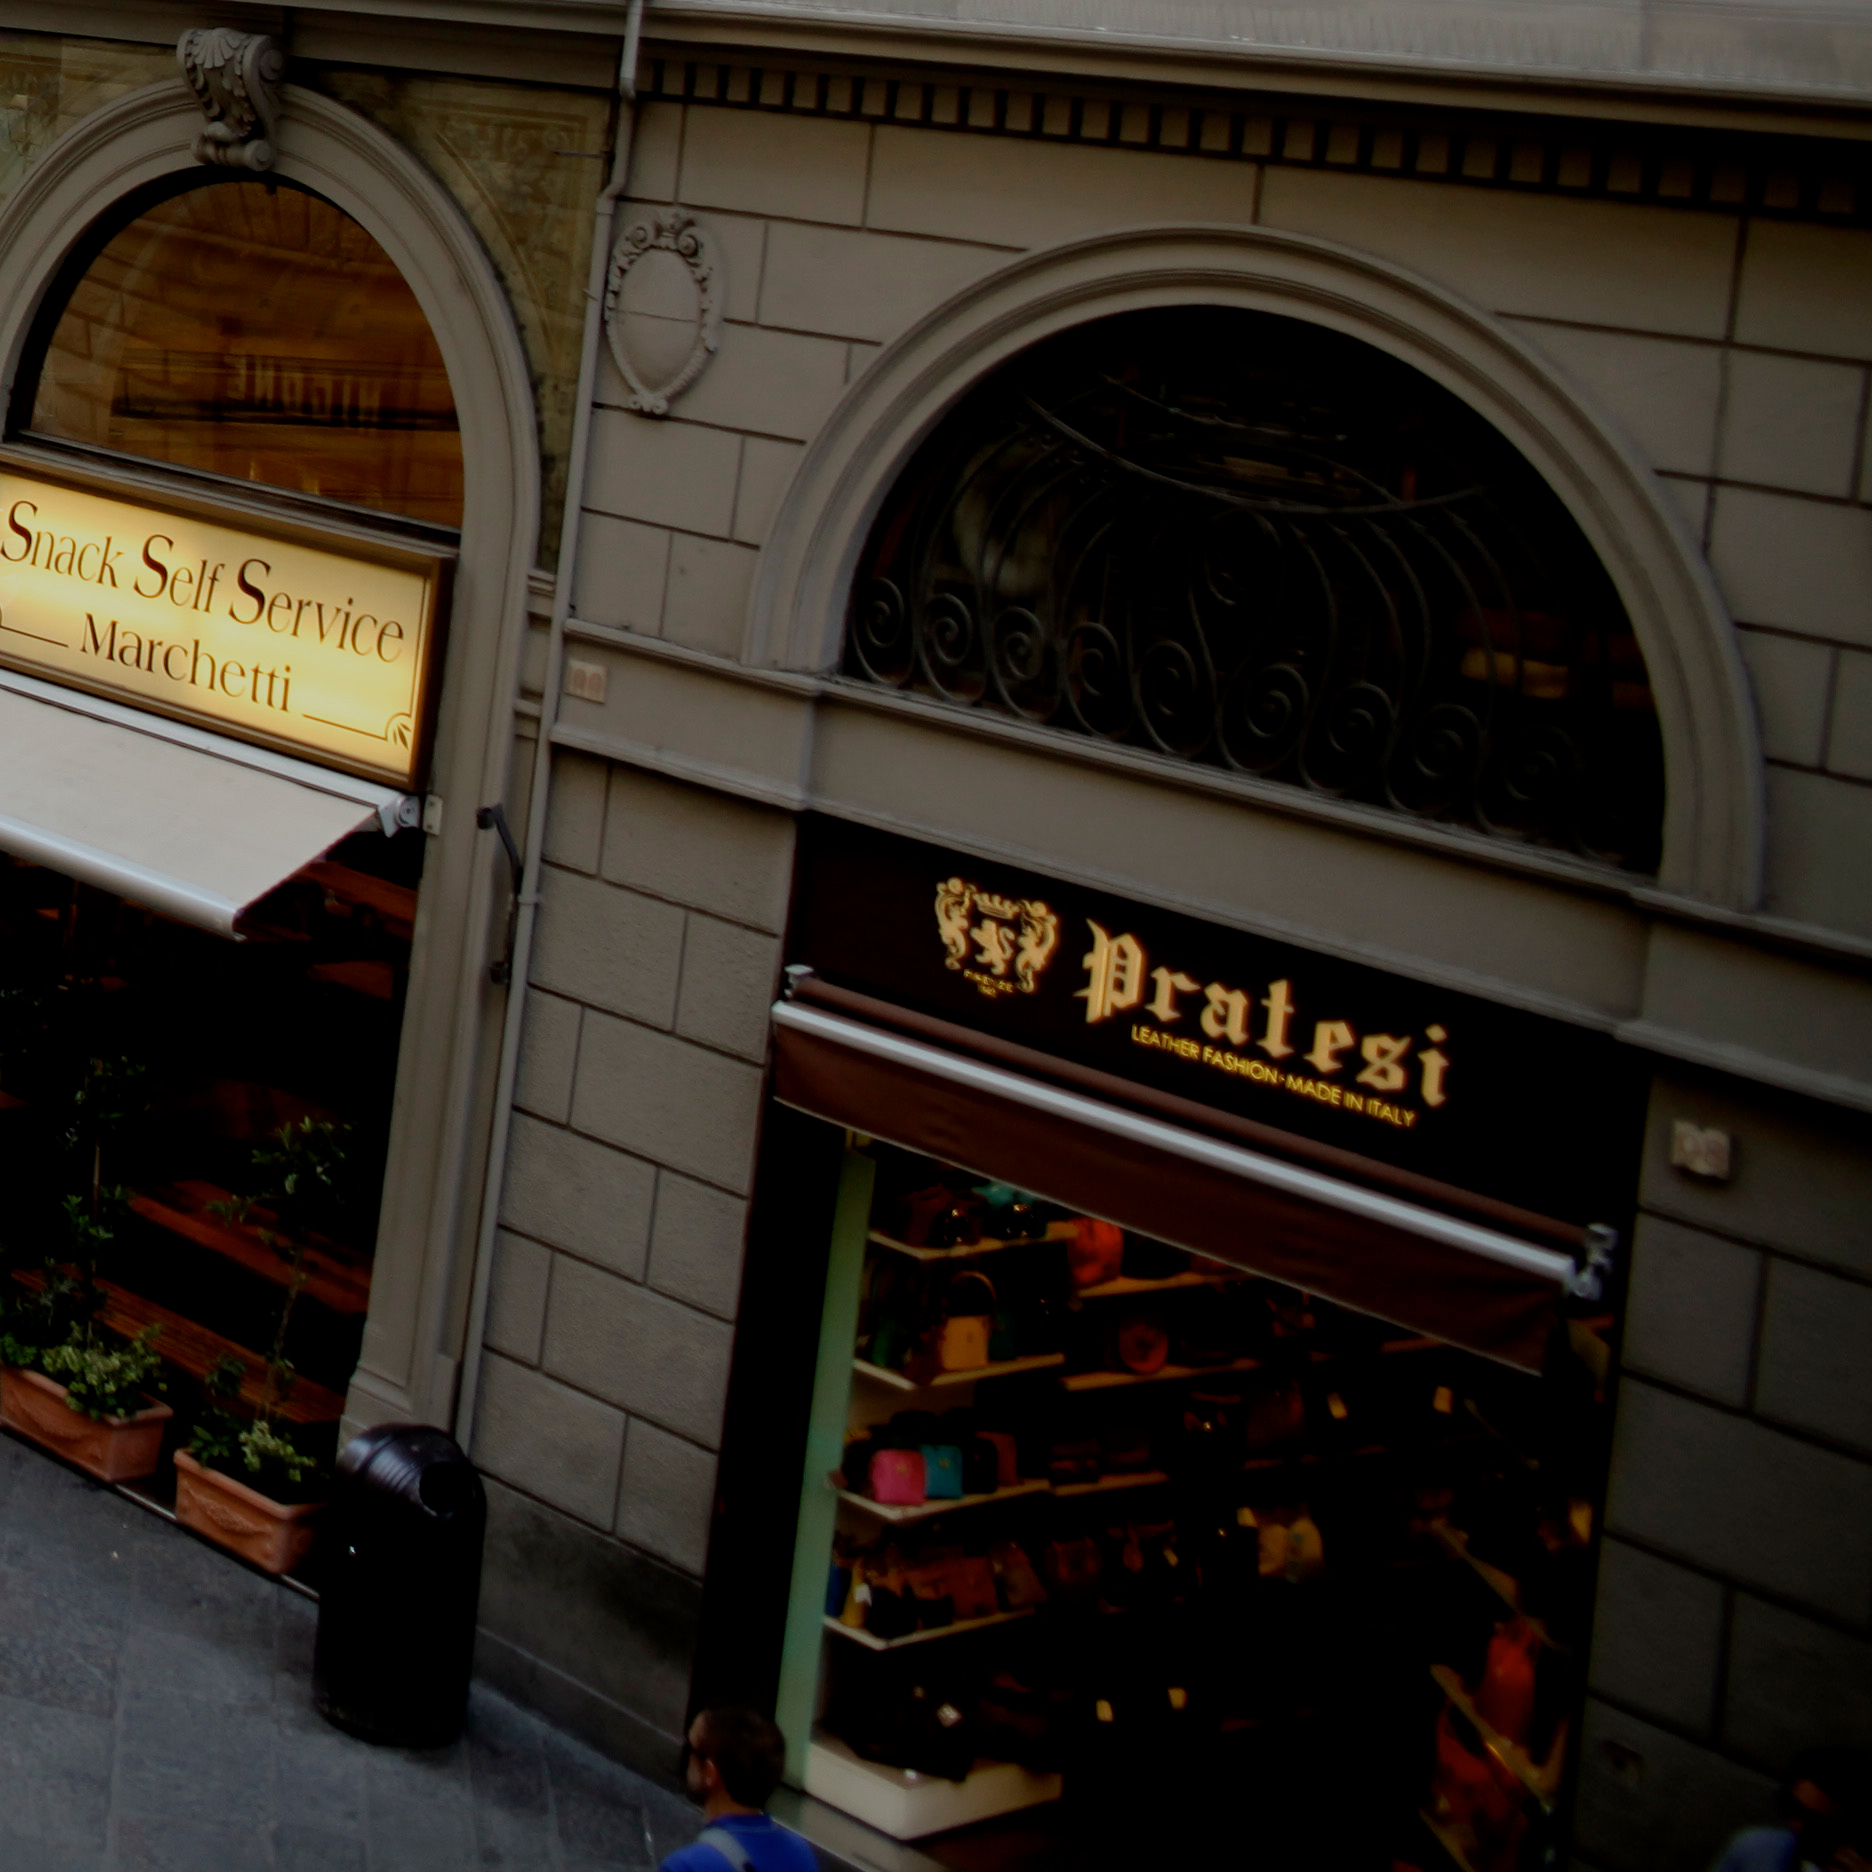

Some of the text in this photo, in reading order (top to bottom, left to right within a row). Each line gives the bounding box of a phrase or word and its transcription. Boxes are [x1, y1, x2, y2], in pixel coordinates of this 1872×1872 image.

[0, 500, 404, 664] Snack Self Service
[79, 613, 293, 714] Marchetti
[1073, 917, 1449, 1108] Pratesi
[1131, 1023, 1416, 1128] LEATHER FASHION MADE IN ITALY
